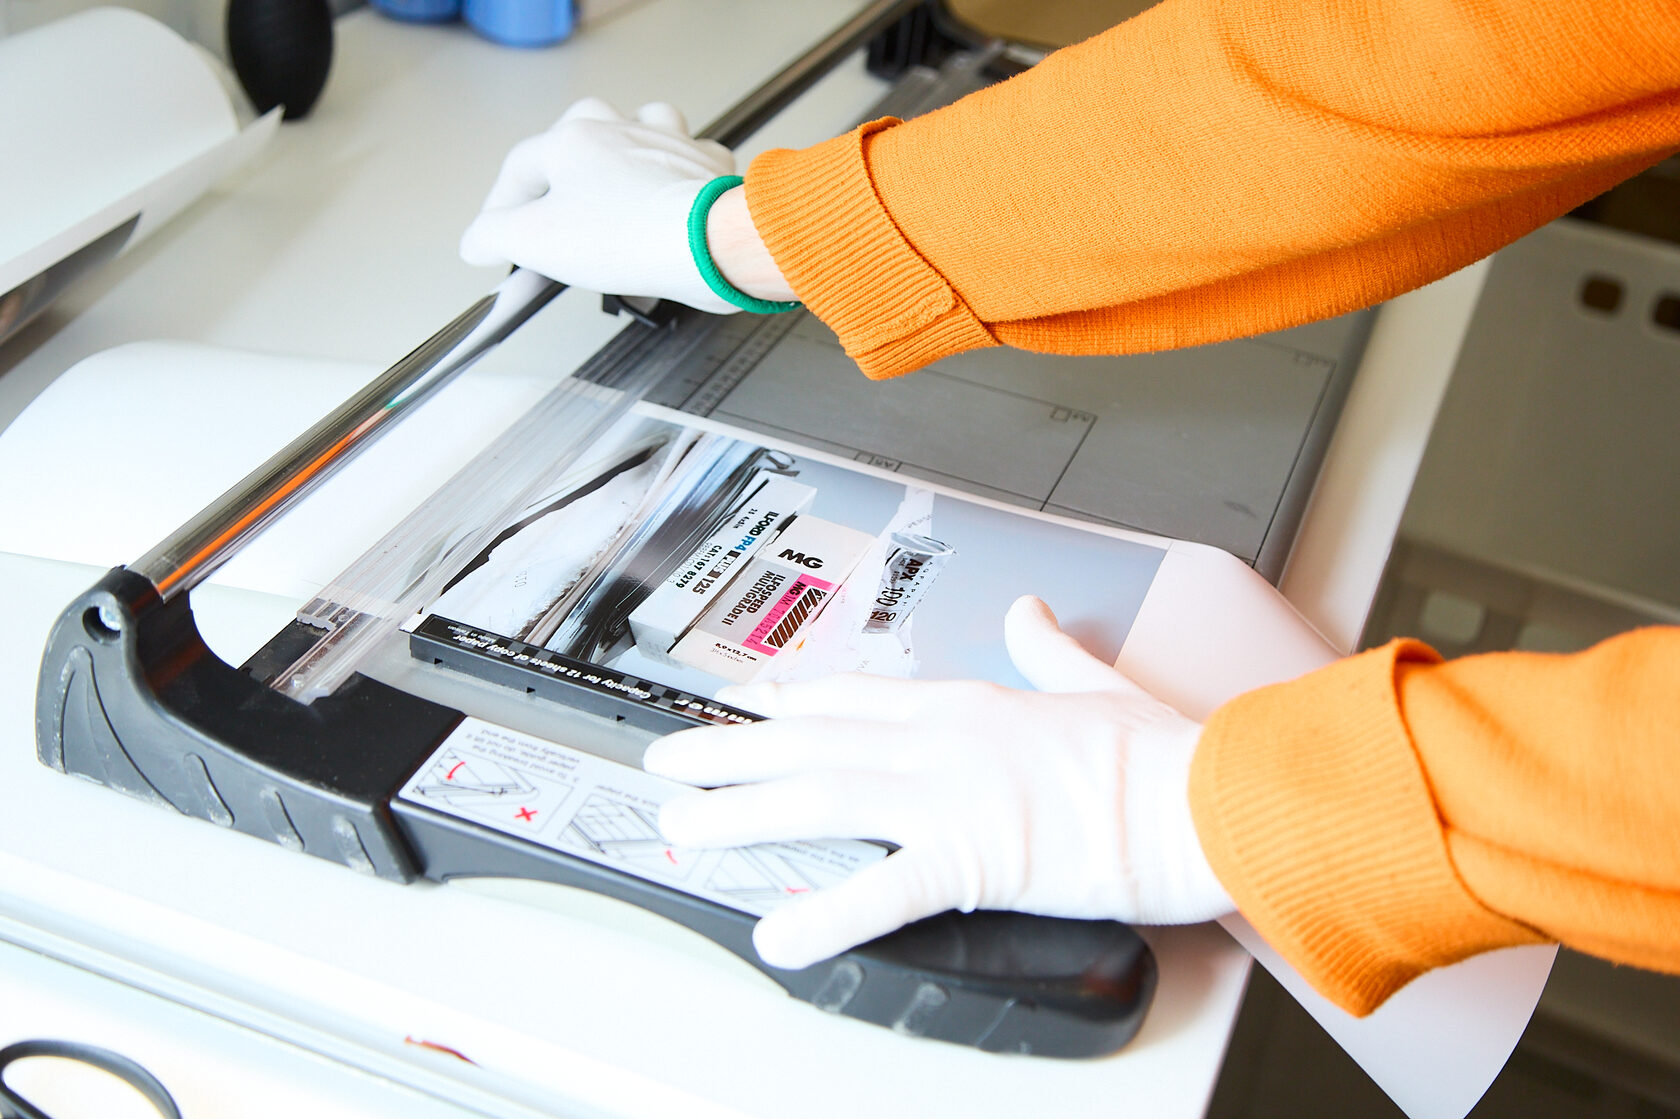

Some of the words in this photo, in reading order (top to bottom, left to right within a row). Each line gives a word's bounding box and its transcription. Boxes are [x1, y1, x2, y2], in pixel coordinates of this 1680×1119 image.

[749, 511, 779, 536] ILFORD
[734, 536, 756, 551] FP4
[713, 552, 737, 575] PLUS
[778, 549, 824, 570] MG
[900, 558, 924, 580] APX
[676, 571, 697, 588] 8279
[692, 578, 715, 594] 125
[727, 570, 771, 621] MULTIGRADE
[746, 574, 786, 613] ILFOSPEED
[875, 586, 906, 606] 100
[869, 610, 897, 621] 120
[453, 634, 489, 649] paper
[477, 634, 497, 643] Made
[487, 643, 516, 658] copy
[513, 651, 530, 662] of
[530, 657, 567, 674] sheets
[566, 670, 583, 678] 12
[582, 673, 601, 685] for
[602, 678, 652, 699] Capacity
[674, 699, 753, 724] mmer
